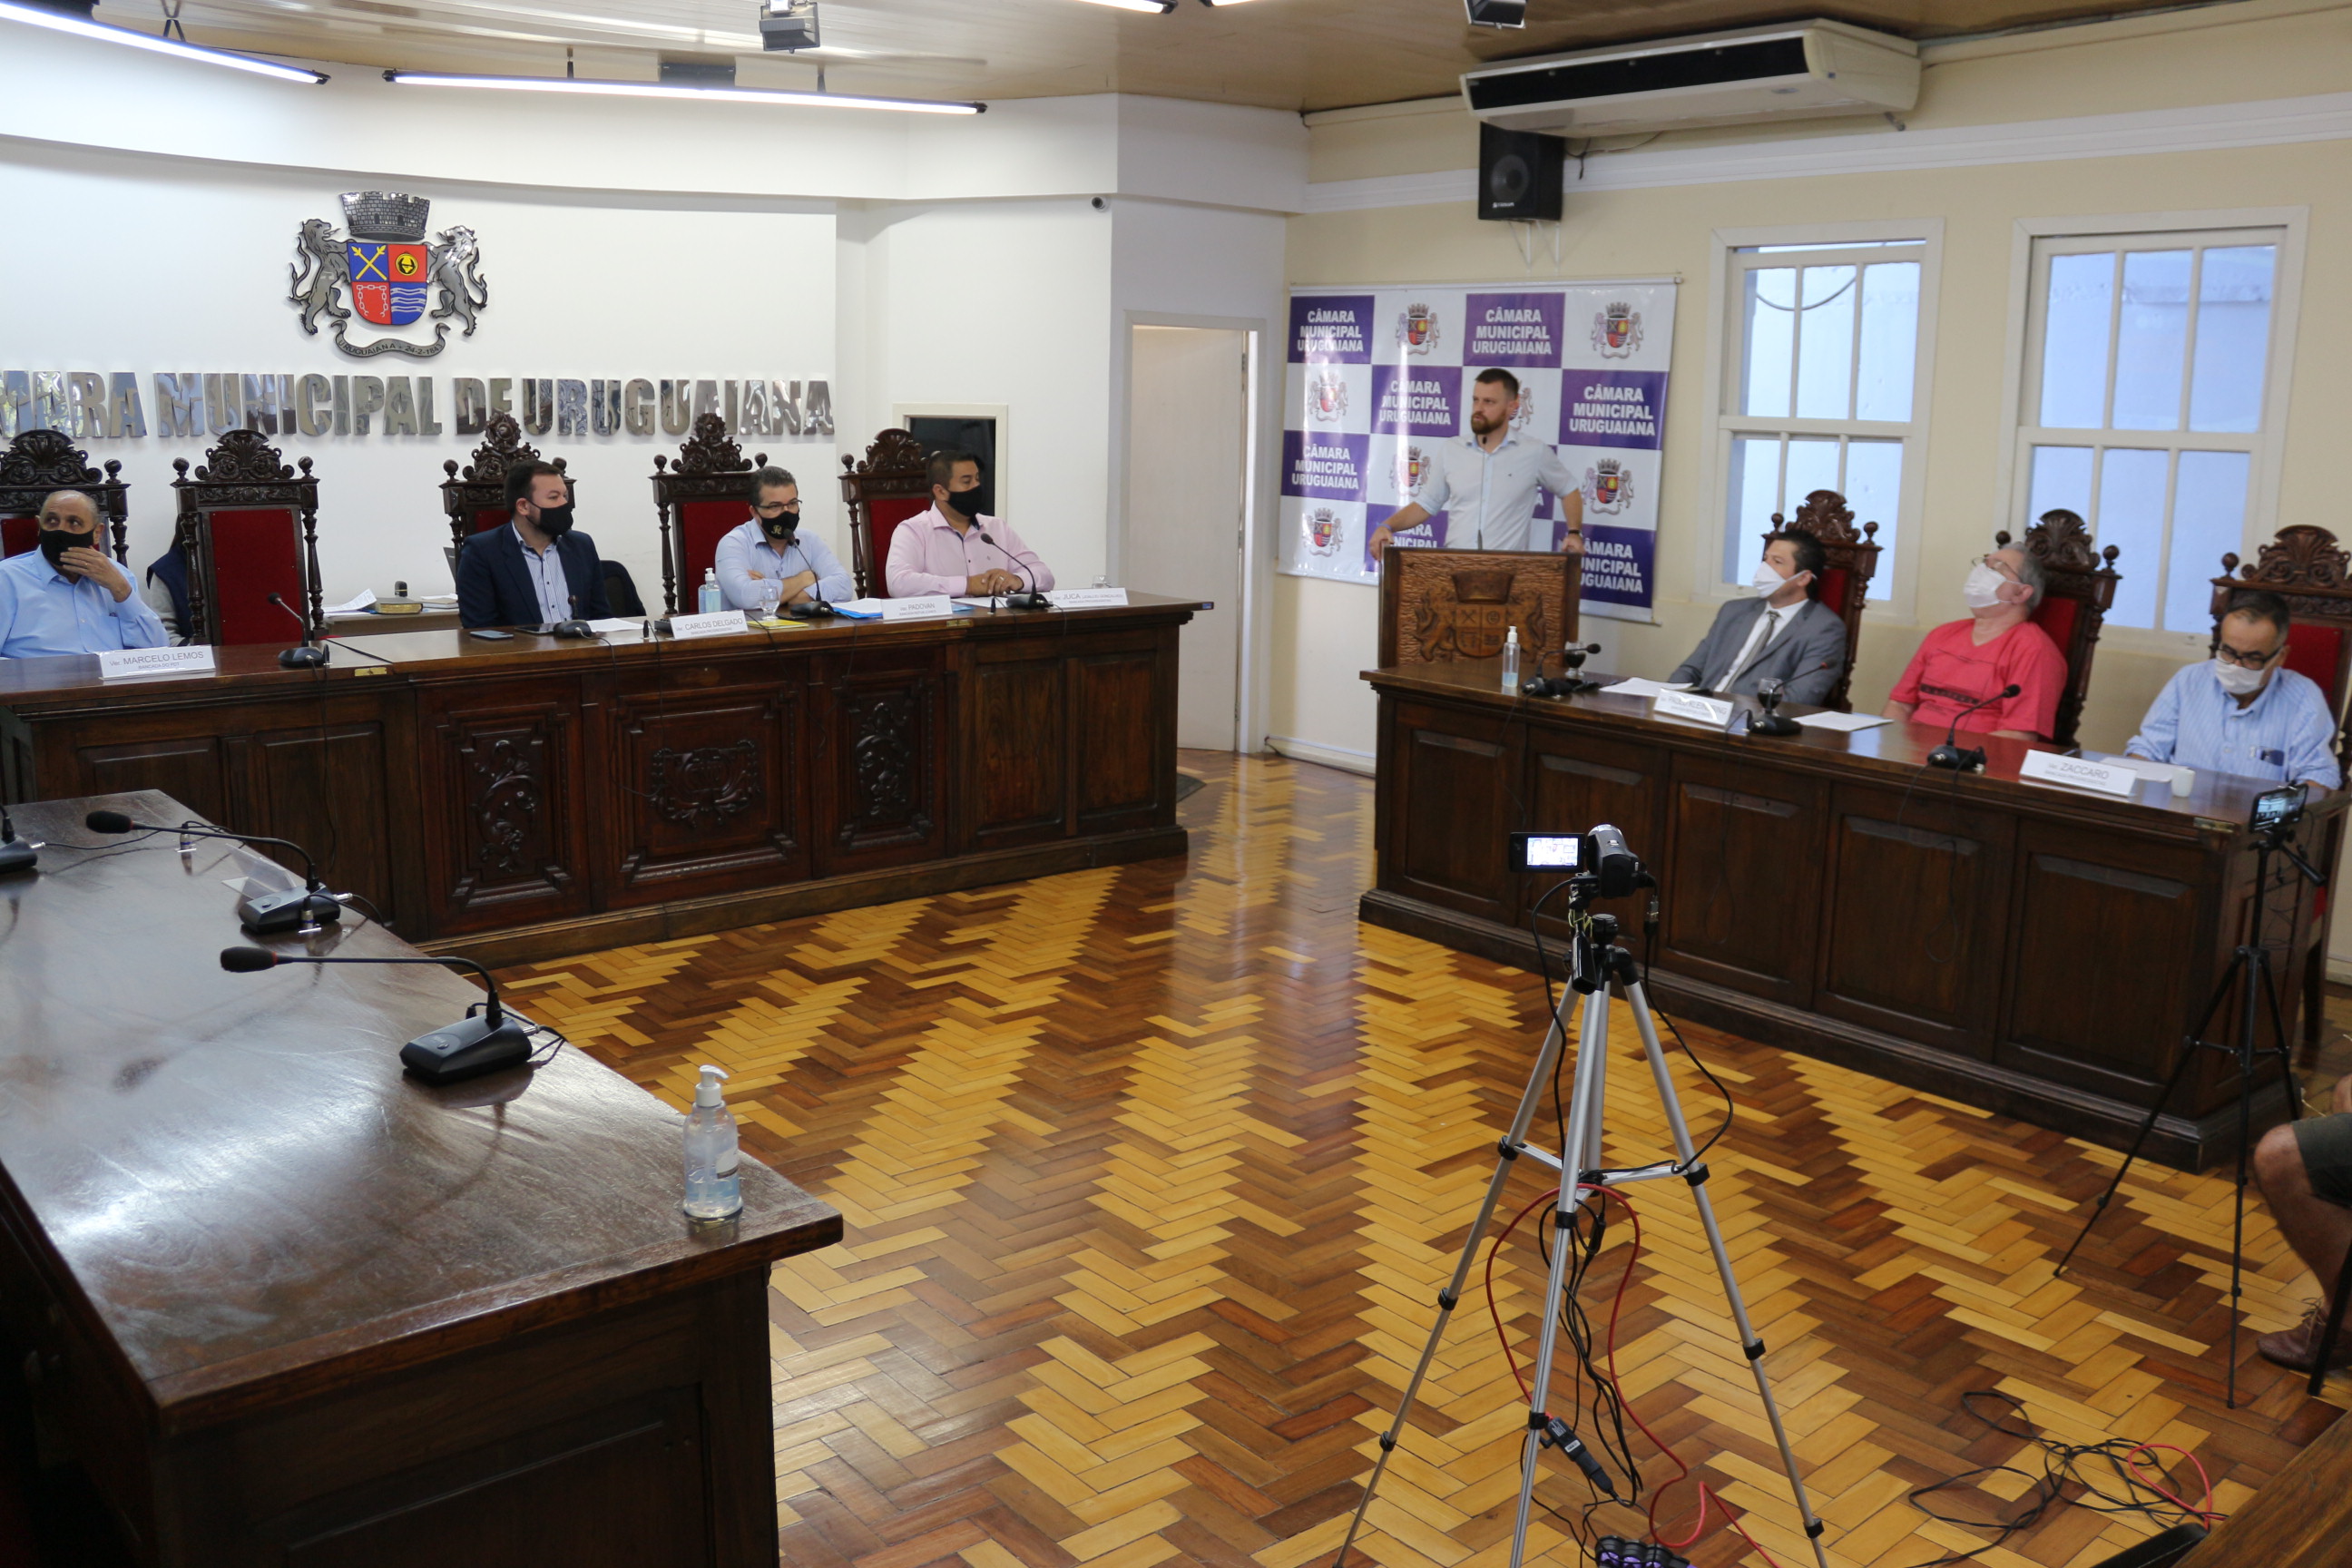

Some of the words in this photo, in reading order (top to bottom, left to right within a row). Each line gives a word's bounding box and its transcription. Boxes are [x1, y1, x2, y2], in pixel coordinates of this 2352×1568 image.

[1307, 308, 1356, 323] CÂMARA
[1485, 306, 1542, 322] CÂMARA
[1299, 325, 1362, 338] MUNICIPAL
[1475, 325, 1550, 339] MUNICIPAL
[338, 340, 397, 355] URUGUAIANA
[405, 343, 443, 355] 24-2-1843
[1297, 338, 1364, 352] URUGUAIANA
[1472, 340, 1553, 355] URUGUAIANA
[1390, 377, 1442, 395] CÂMARA
[1583, 383, 1644, 402] CÂMARA
[152, 373, 442, 437] MUNICIPAL
[453, 377, 513, 436] DE
[522, 377, 836, 436] URUGUAIANA
[1382, 395, 1449, 410] MUNICIPAL
[1573, 402, 1653, 419] MUNICIPAL
[1378, 409, 1452, 425] URUGUAIANA
[1569, 418, 1656, 436] URUGUAIANA
[1303, 443, 1351, 460] CÂMARA
[1295, 459, 1357, 475] MUNICIPAL
[1291, 473, 1359, 490] URUGUAIANA
[1583, 537, 1633, 559] ÂMARA
[1580, 573, 1643, 593] UGUAIANA
[907, 603, 936, 611] PADOVAN
[685, 621, 711, 631] CARLOS
[712, 617, 743, 628] DELGADO
[122, 653, 170, 665] MARCELO
[172, 651, 204, 661] LEMOS
[2060, 761, 2110, 779] ZACCARO
